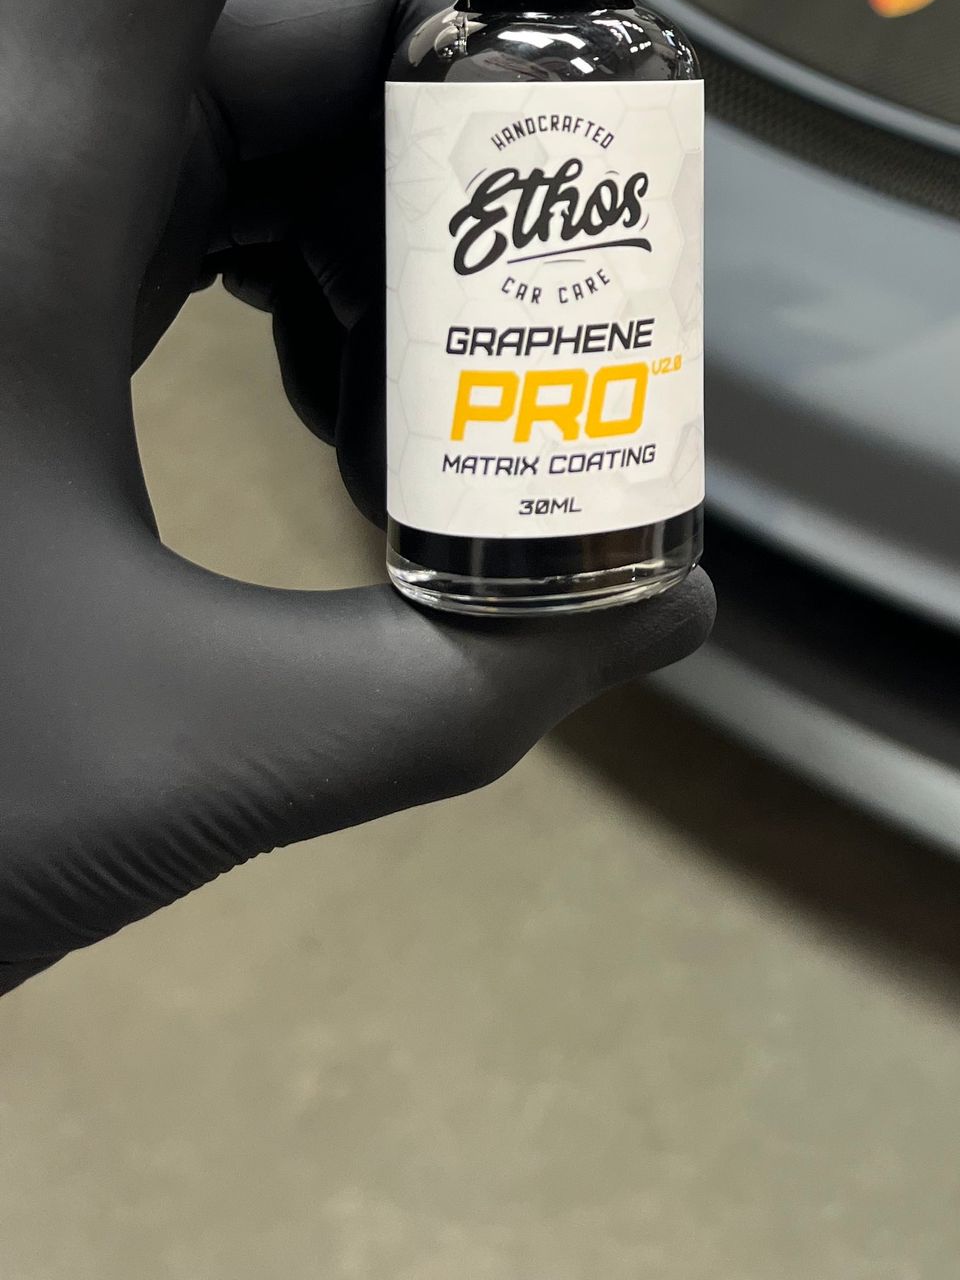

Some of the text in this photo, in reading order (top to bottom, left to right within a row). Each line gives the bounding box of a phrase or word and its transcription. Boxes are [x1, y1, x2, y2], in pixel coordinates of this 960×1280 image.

[490, 114, 615, 151] HANDCRAFTED
[448, 157, 650, 276] Ethos
[501, 268, 611, 304] CAR CARE
[445, 317, 656, 357] GRAPHENE
[450, 361, 649, 443] PRO
[442, 443, 657, 476] MATRIX COATING
[518, 496, 583, 516] 30ML
